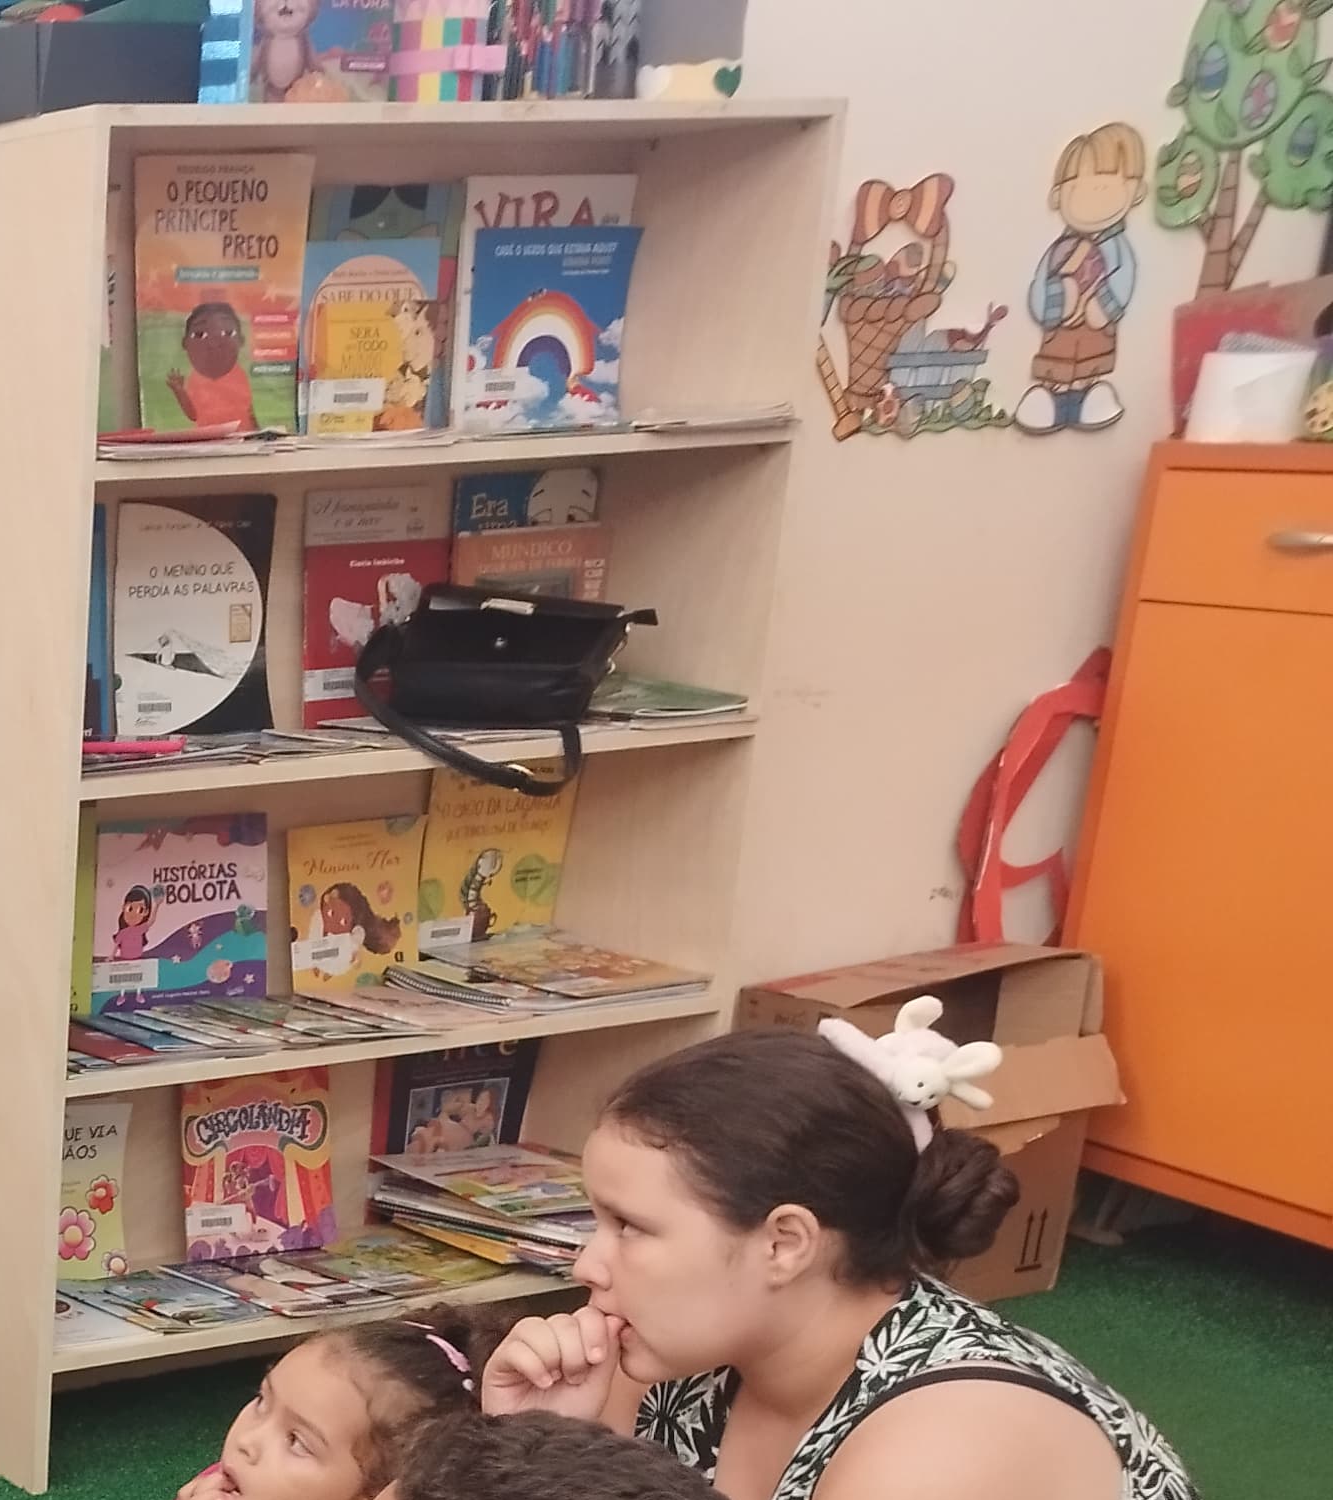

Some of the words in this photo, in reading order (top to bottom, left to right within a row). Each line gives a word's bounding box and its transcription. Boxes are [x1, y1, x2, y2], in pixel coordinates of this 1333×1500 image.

[167, 181, 179, 201] O
[185, 179, 269, 204] PEQUENO
[474, 190, 595, 228] VIRA
[222, 234, 279, 259] PRETO
[469, 493, 509, 519] Era
[149, 566, 158, 578] O
[164, 564, 206, 577] MENINO
[211, 562, 235, 576] QUE
[128, 584, 170, 599] PERDIA
[173, 584, 189, 596] AS
[193, 581, 254, 594] PALAVRAS
[153, 860, 237, 883] HISTÓRIAS
[166, 880, 241, 904] BOLOTA
[64, 1127, 82, 1141] UE
[89, 1125, 118, 1139] VIA
[62, 1144, 97, 1161] ÃOS
